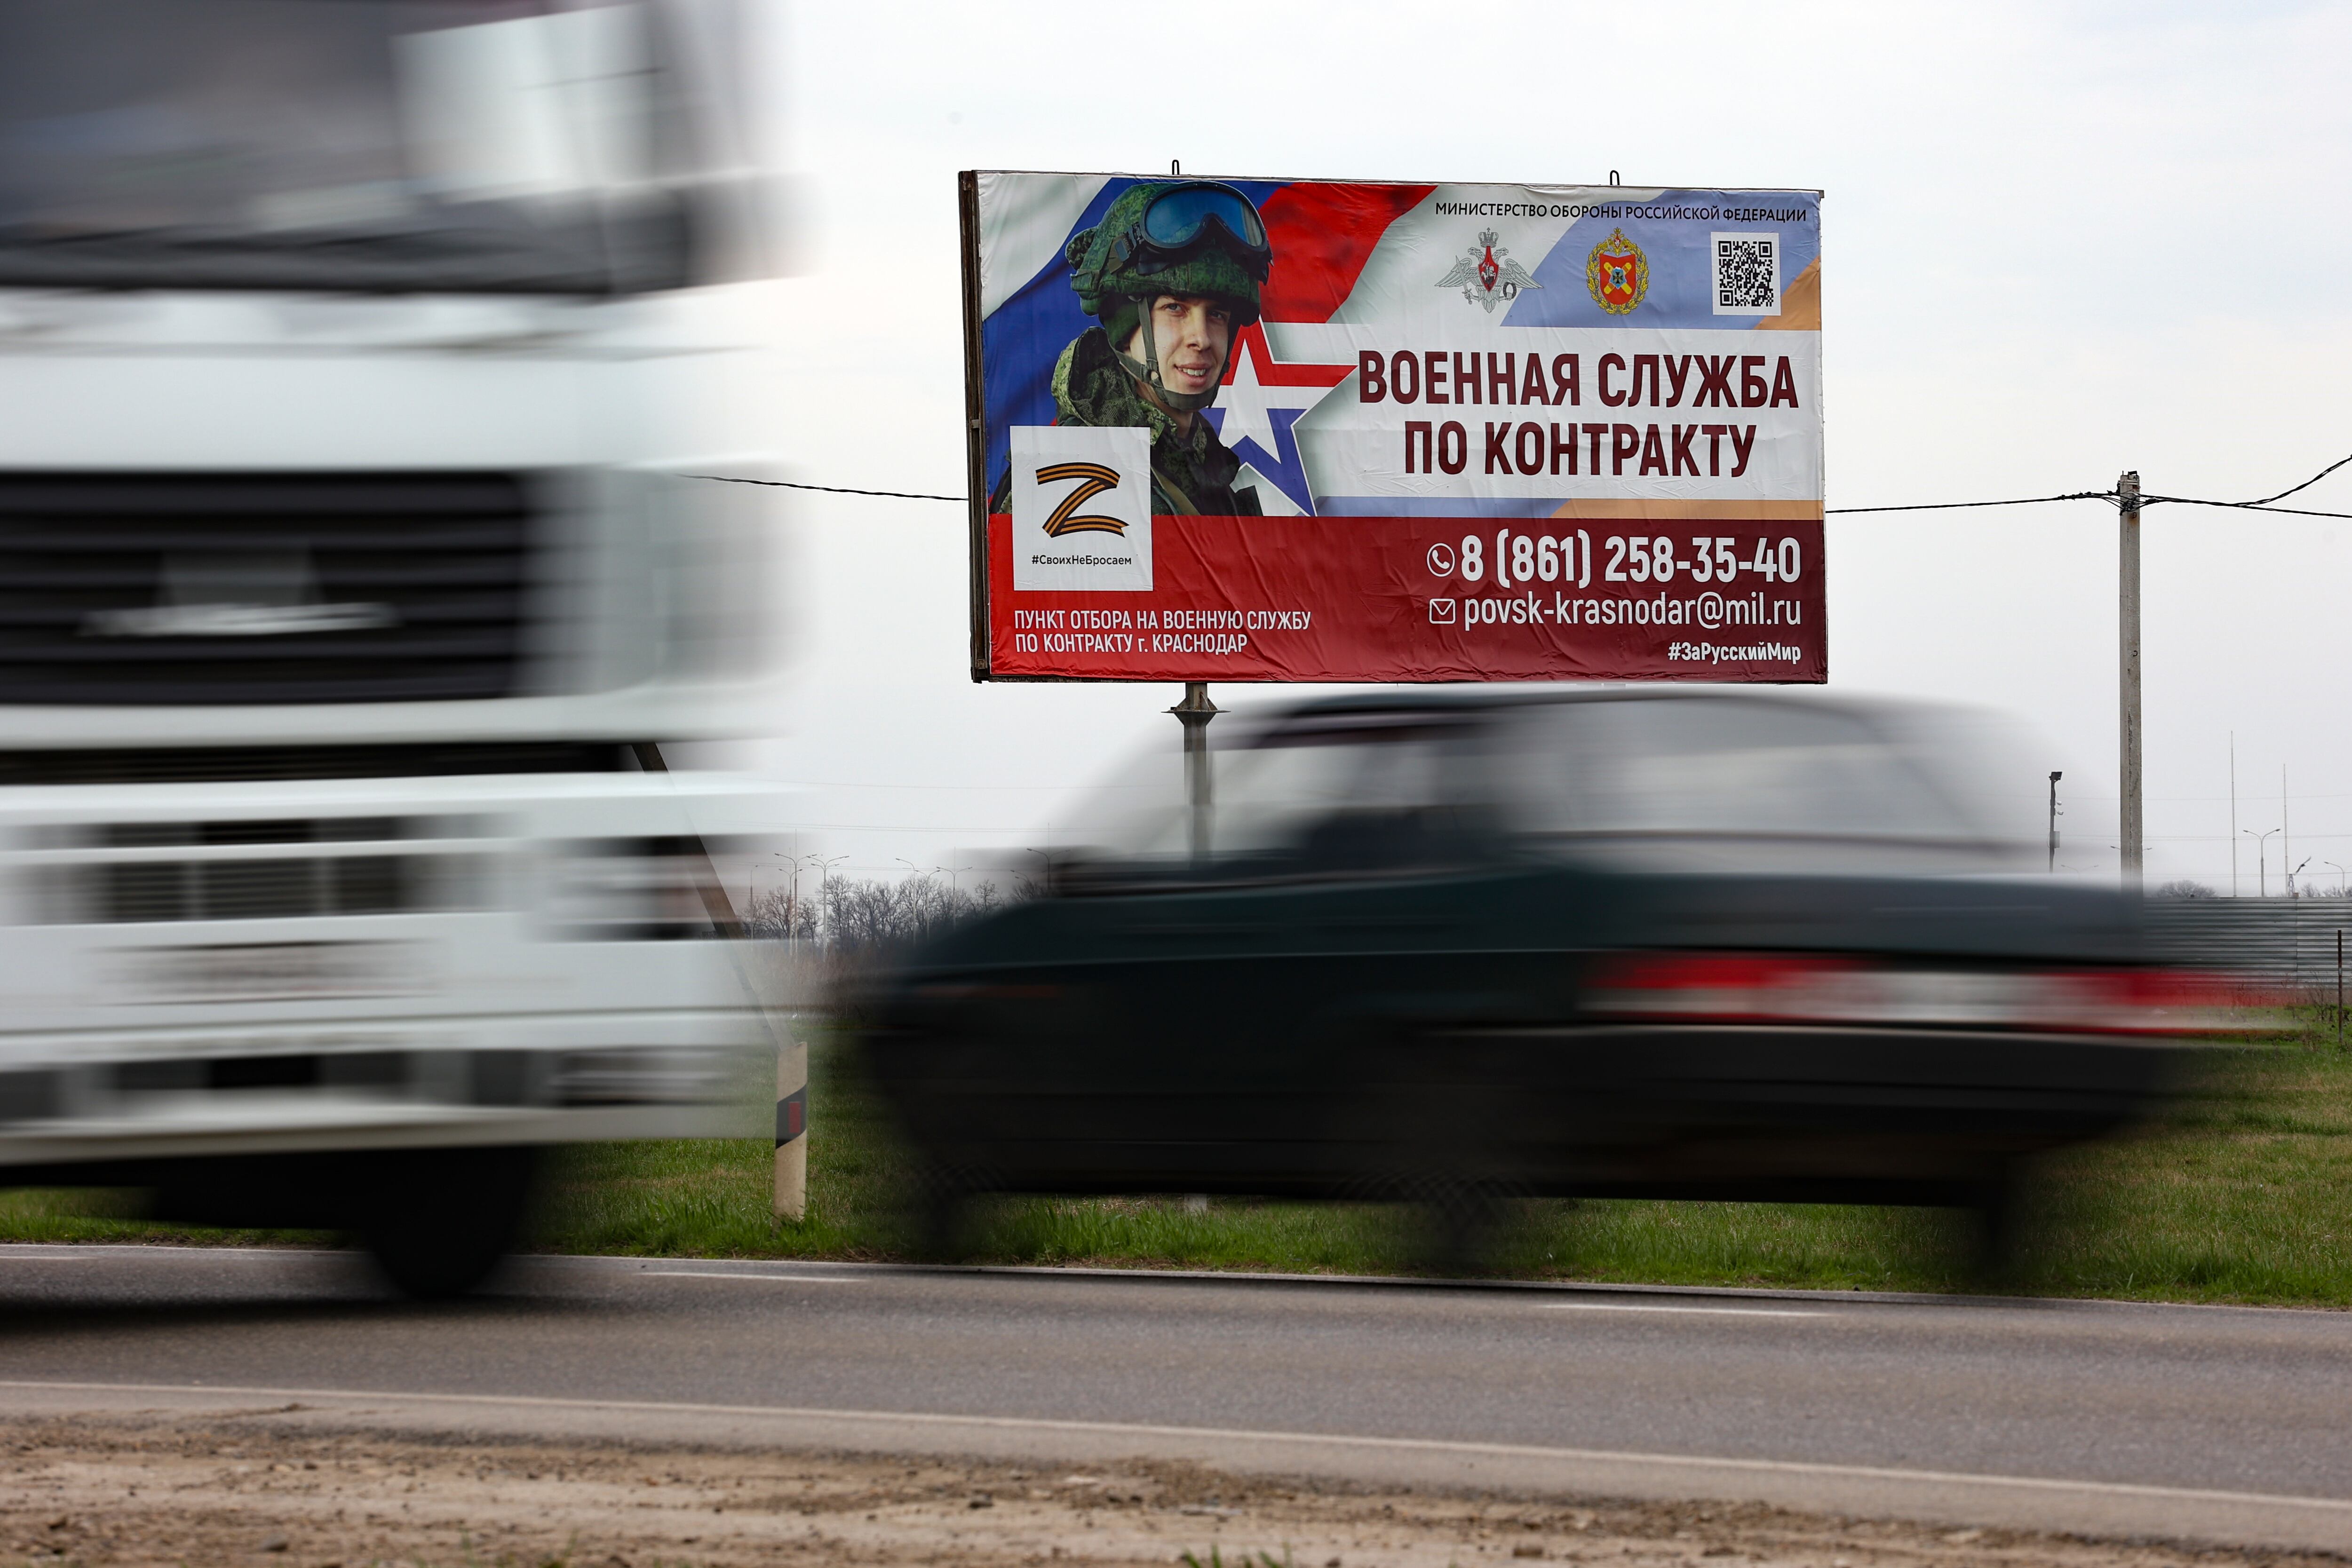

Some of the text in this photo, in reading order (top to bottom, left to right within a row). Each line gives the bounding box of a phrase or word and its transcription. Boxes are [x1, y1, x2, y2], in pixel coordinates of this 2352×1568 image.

[1436, 202, 1806, 223] МИНИСТЕРСТВО ОБОРОНЫ РОССИЙСКОЙ ФЕДЕРАЦИИ
[1359, 350, 1799, 408] ВОЕННАЯ СЛУЖБА
[1405, 420, 1757, 478] ПО КОНТРАКТУ
[1035, 462, 1130, 539] Z
[1032, 554, 1131, 566] #СвоихНеБросаем
[1461, 528, 1801, 589] 8 (861) 258-35-40
[1015, 610, 1311, 630] ПУНКТ ОТБОРА НА ВОЕННУЮ СЛУЖБУ
[1465, 591, 1801, 631] povsk-krasnodar@mil.ru
[1016, 634, 1248, 655] ПО КОНТРАКТУ г. КРАСНОДАР
[1668, 641, 1801, 665] #ЗаРусскийМир
